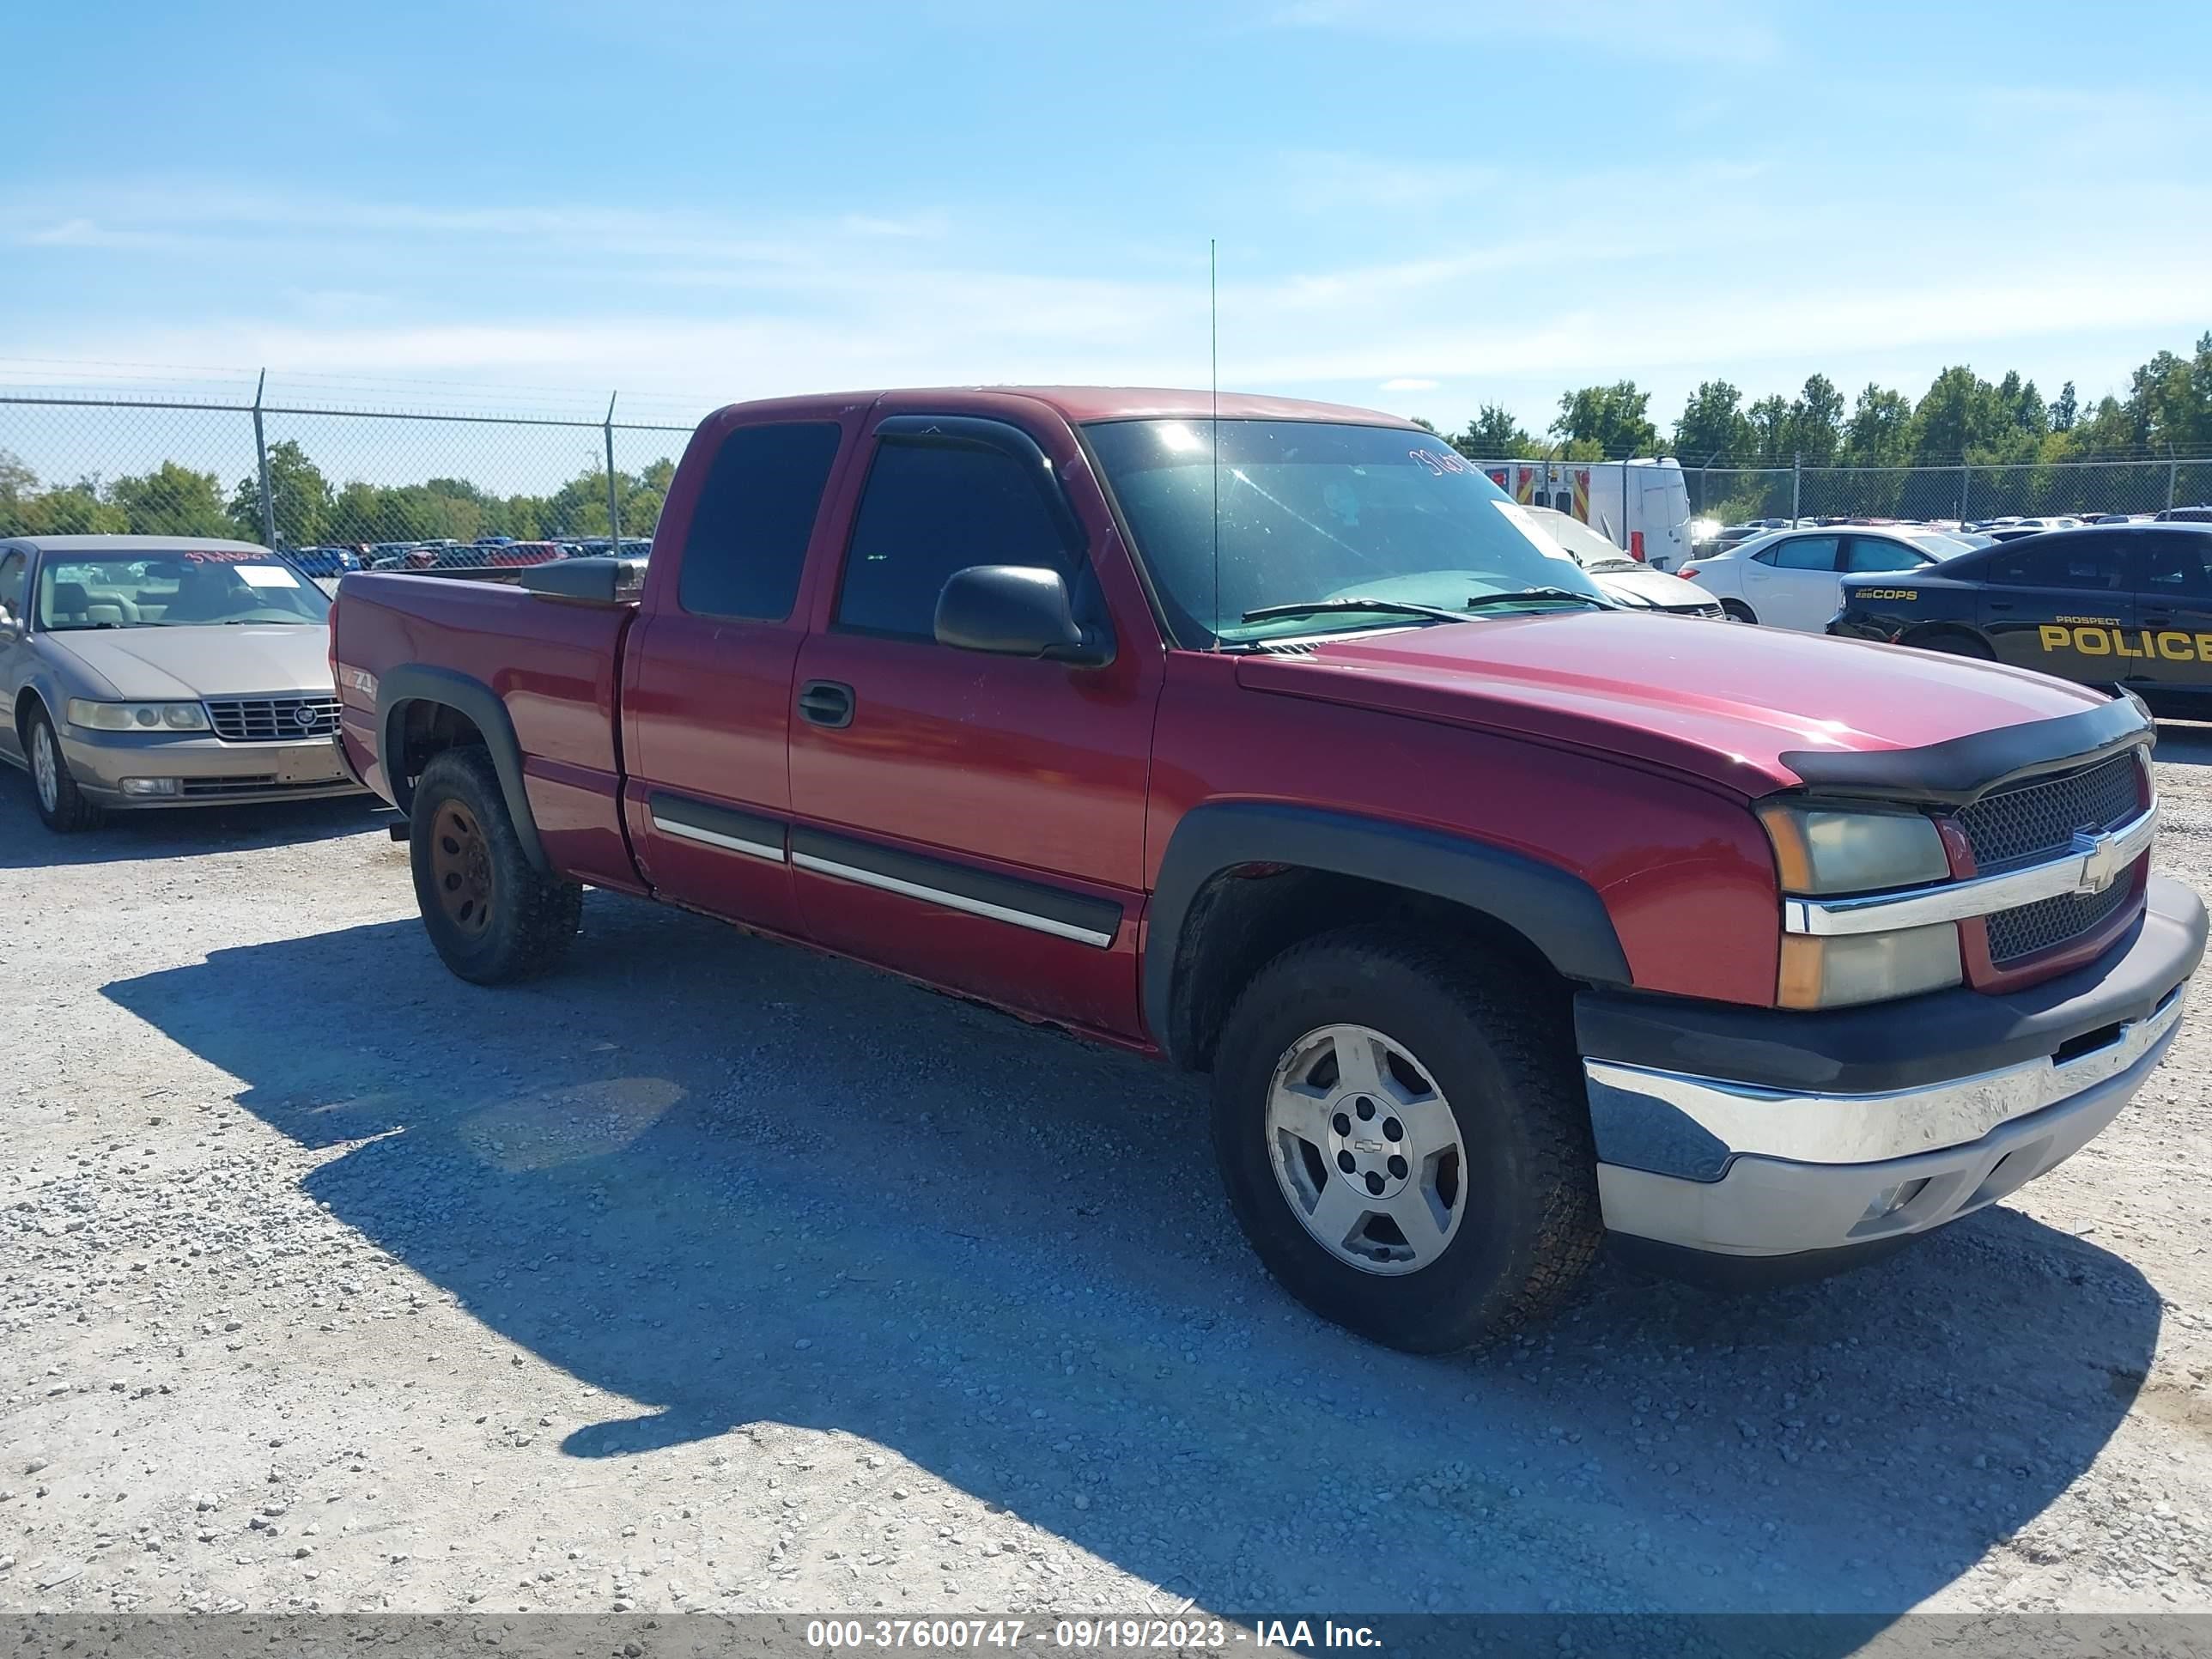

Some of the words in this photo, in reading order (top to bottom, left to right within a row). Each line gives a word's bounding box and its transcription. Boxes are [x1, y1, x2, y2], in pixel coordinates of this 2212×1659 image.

[1873, 589, 1917, 600] COPS
[2056, 615, 2122, 626] PROSPECT
[2039, 625, 2212, 662] POLICE
